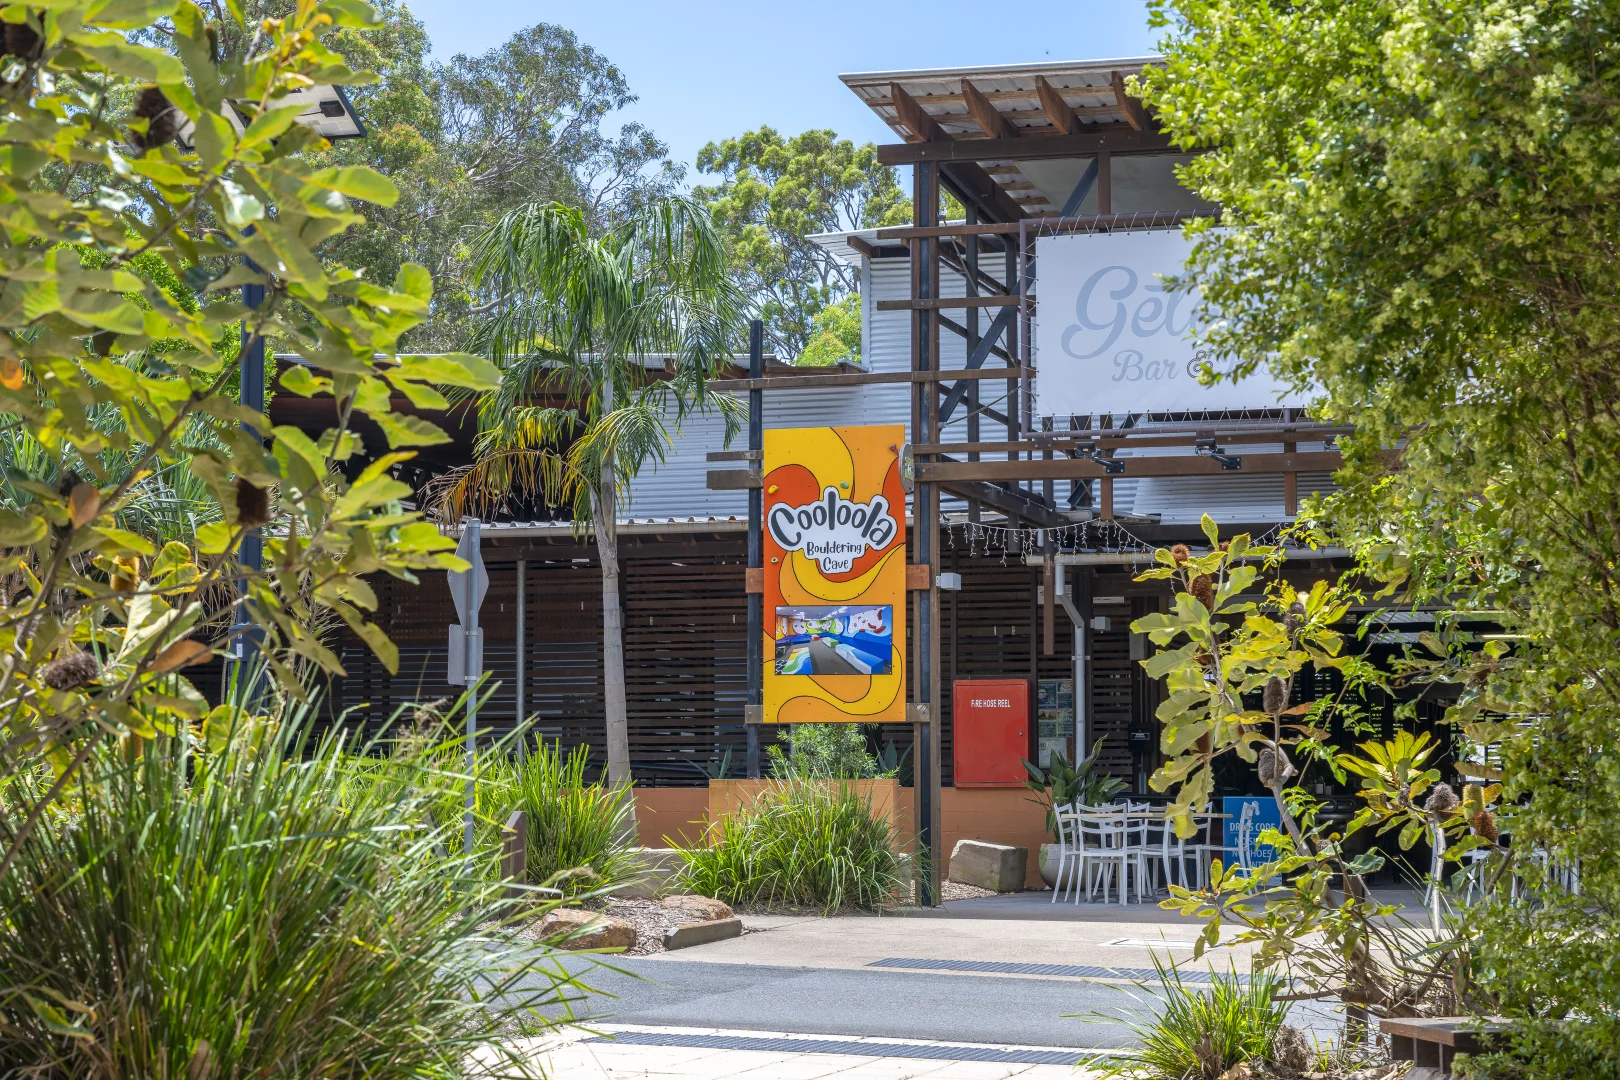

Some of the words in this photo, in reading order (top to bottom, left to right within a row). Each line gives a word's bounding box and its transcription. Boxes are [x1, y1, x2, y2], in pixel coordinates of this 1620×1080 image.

[1112, 349, 1180, 381] Bar
[771, 491, 893, 547] Cooloola
[807, 541, 862, 556] Bouldering
[823, 557, 849, 571] Cave
[971, 699, 983, 708] FIRE
[983, 699, 997, 708] HOSE
[998, 699, 1011, 708] REEL
